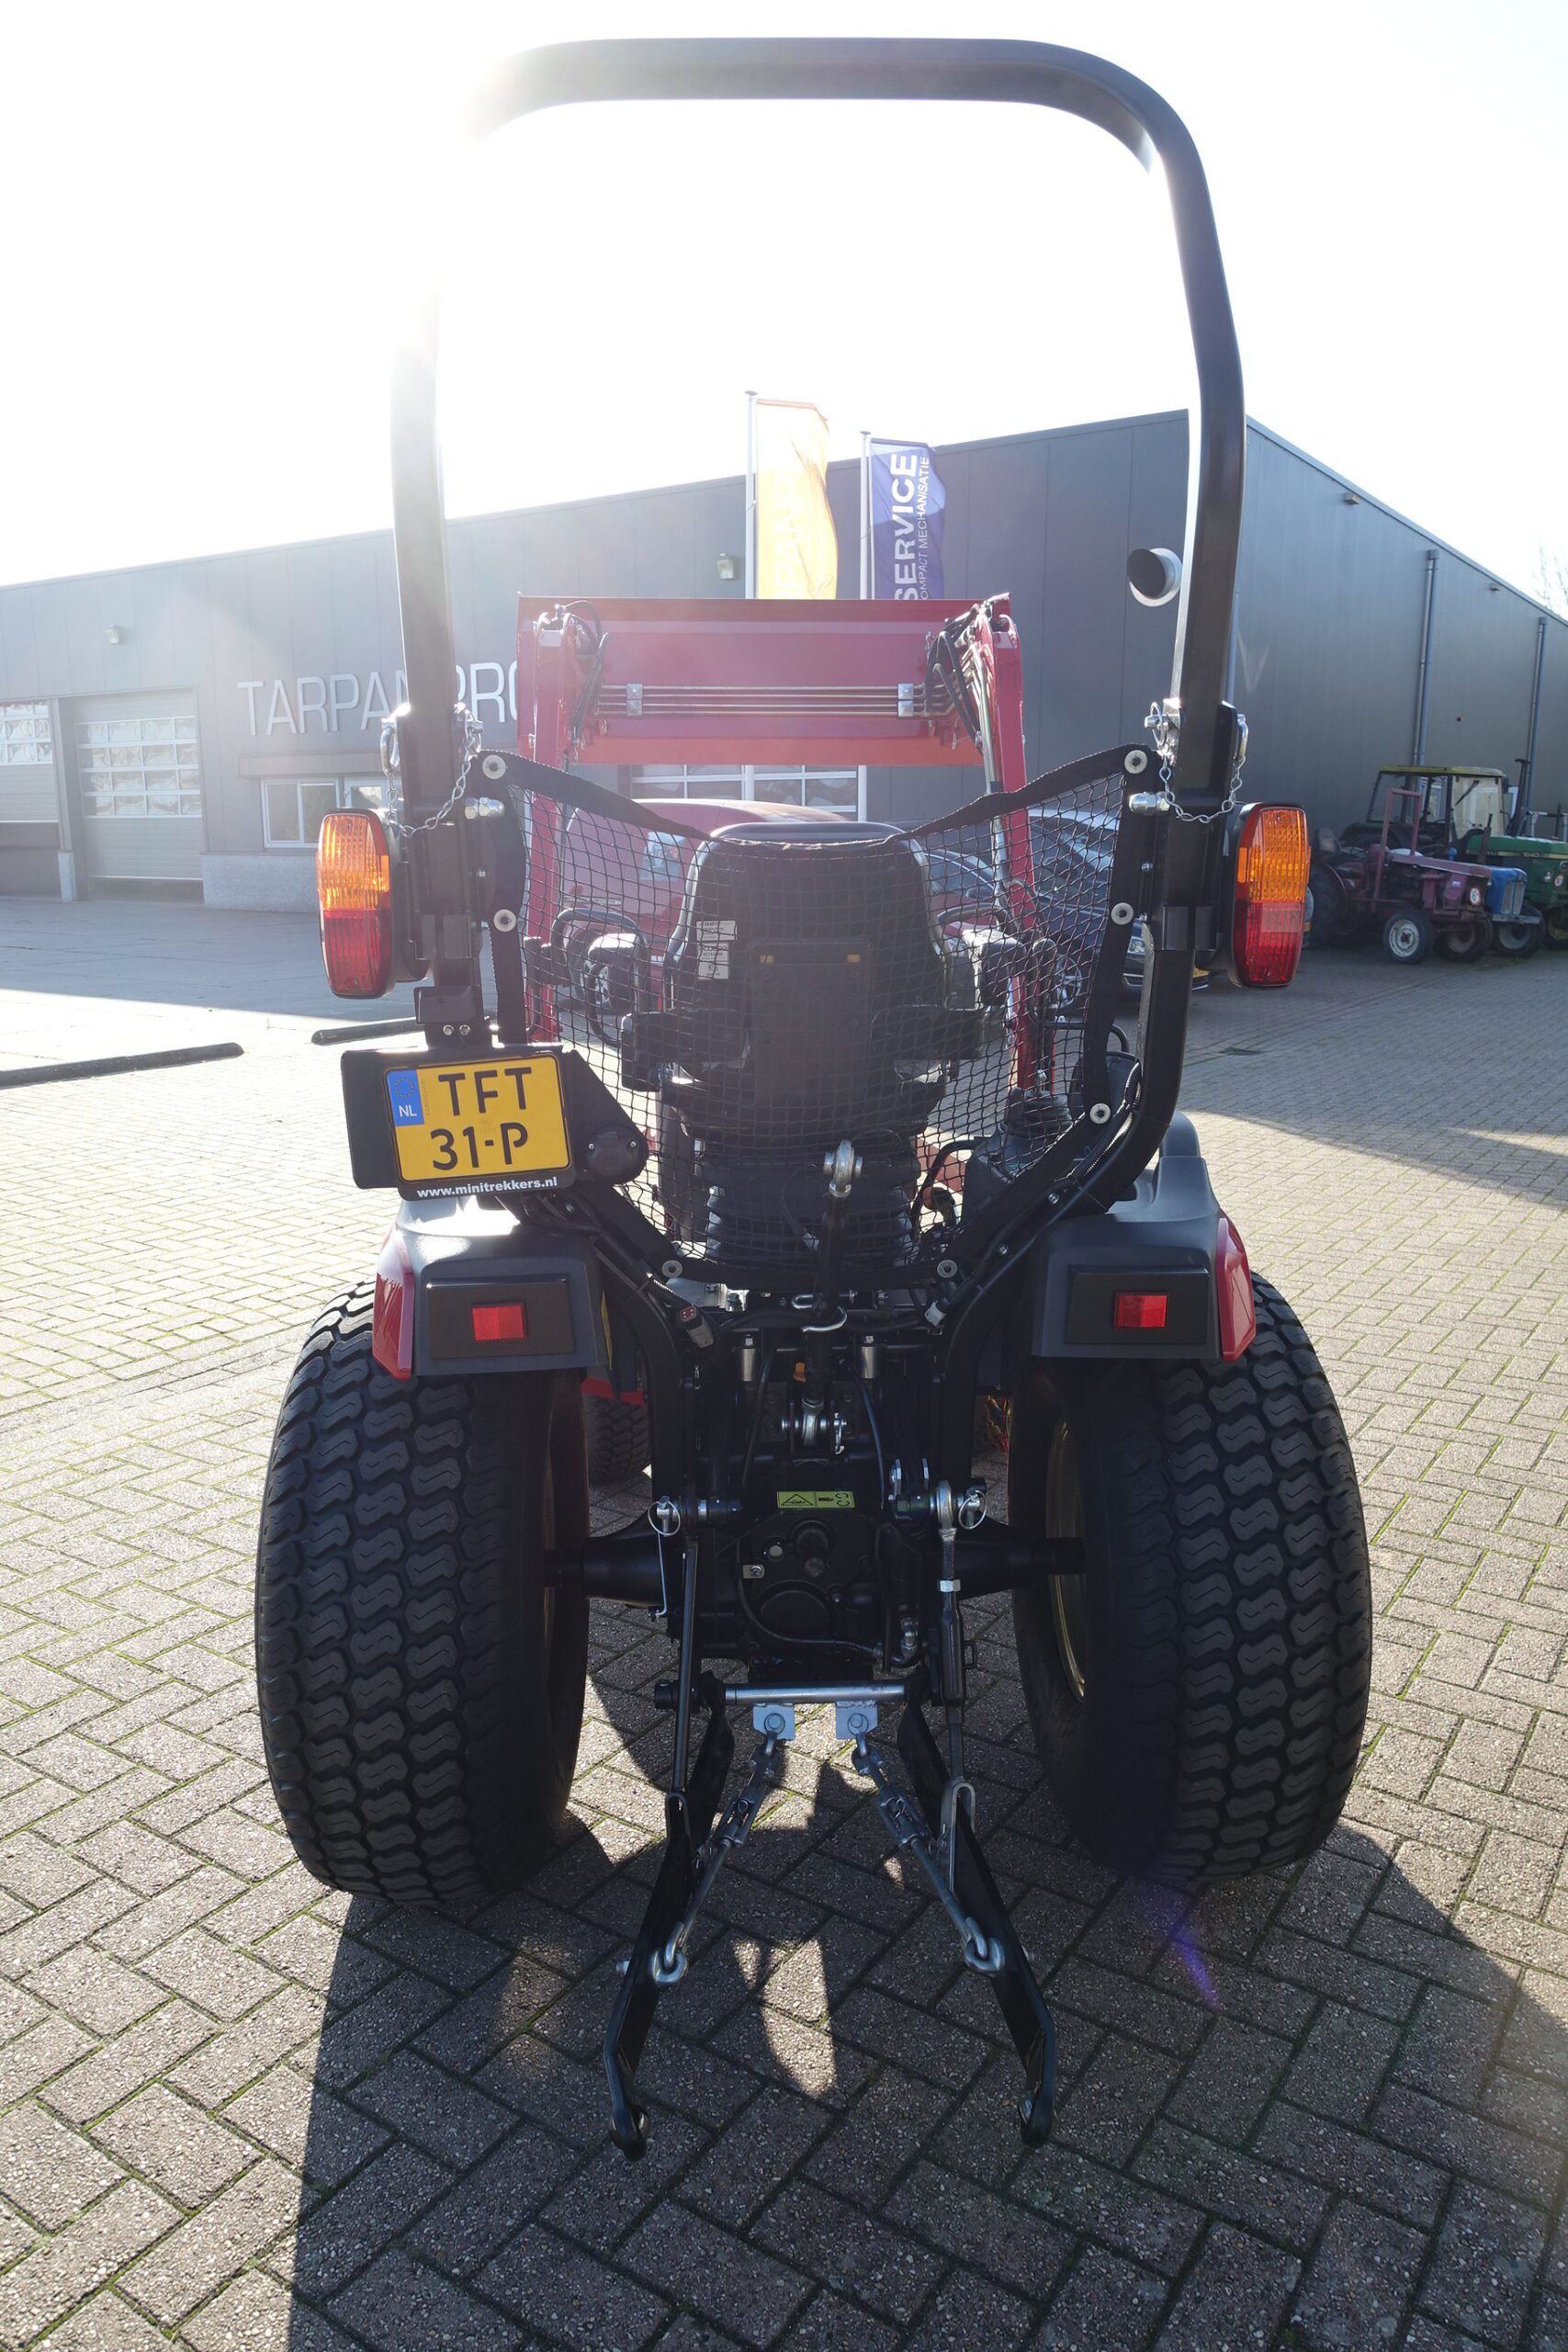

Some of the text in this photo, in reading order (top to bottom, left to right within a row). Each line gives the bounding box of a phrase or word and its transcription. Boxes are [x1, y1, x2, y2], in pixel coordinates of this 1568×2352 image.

[916, 456, 930, 599] OMPACT MECHANISATIE
[399, 1104, 417, 1118] NL
[438, 1067, 532, 1116] TFT
[430, 1122, 529, 1171] 31-P
[417, 1177, 558, 1198] www.minitrekkers.nl
